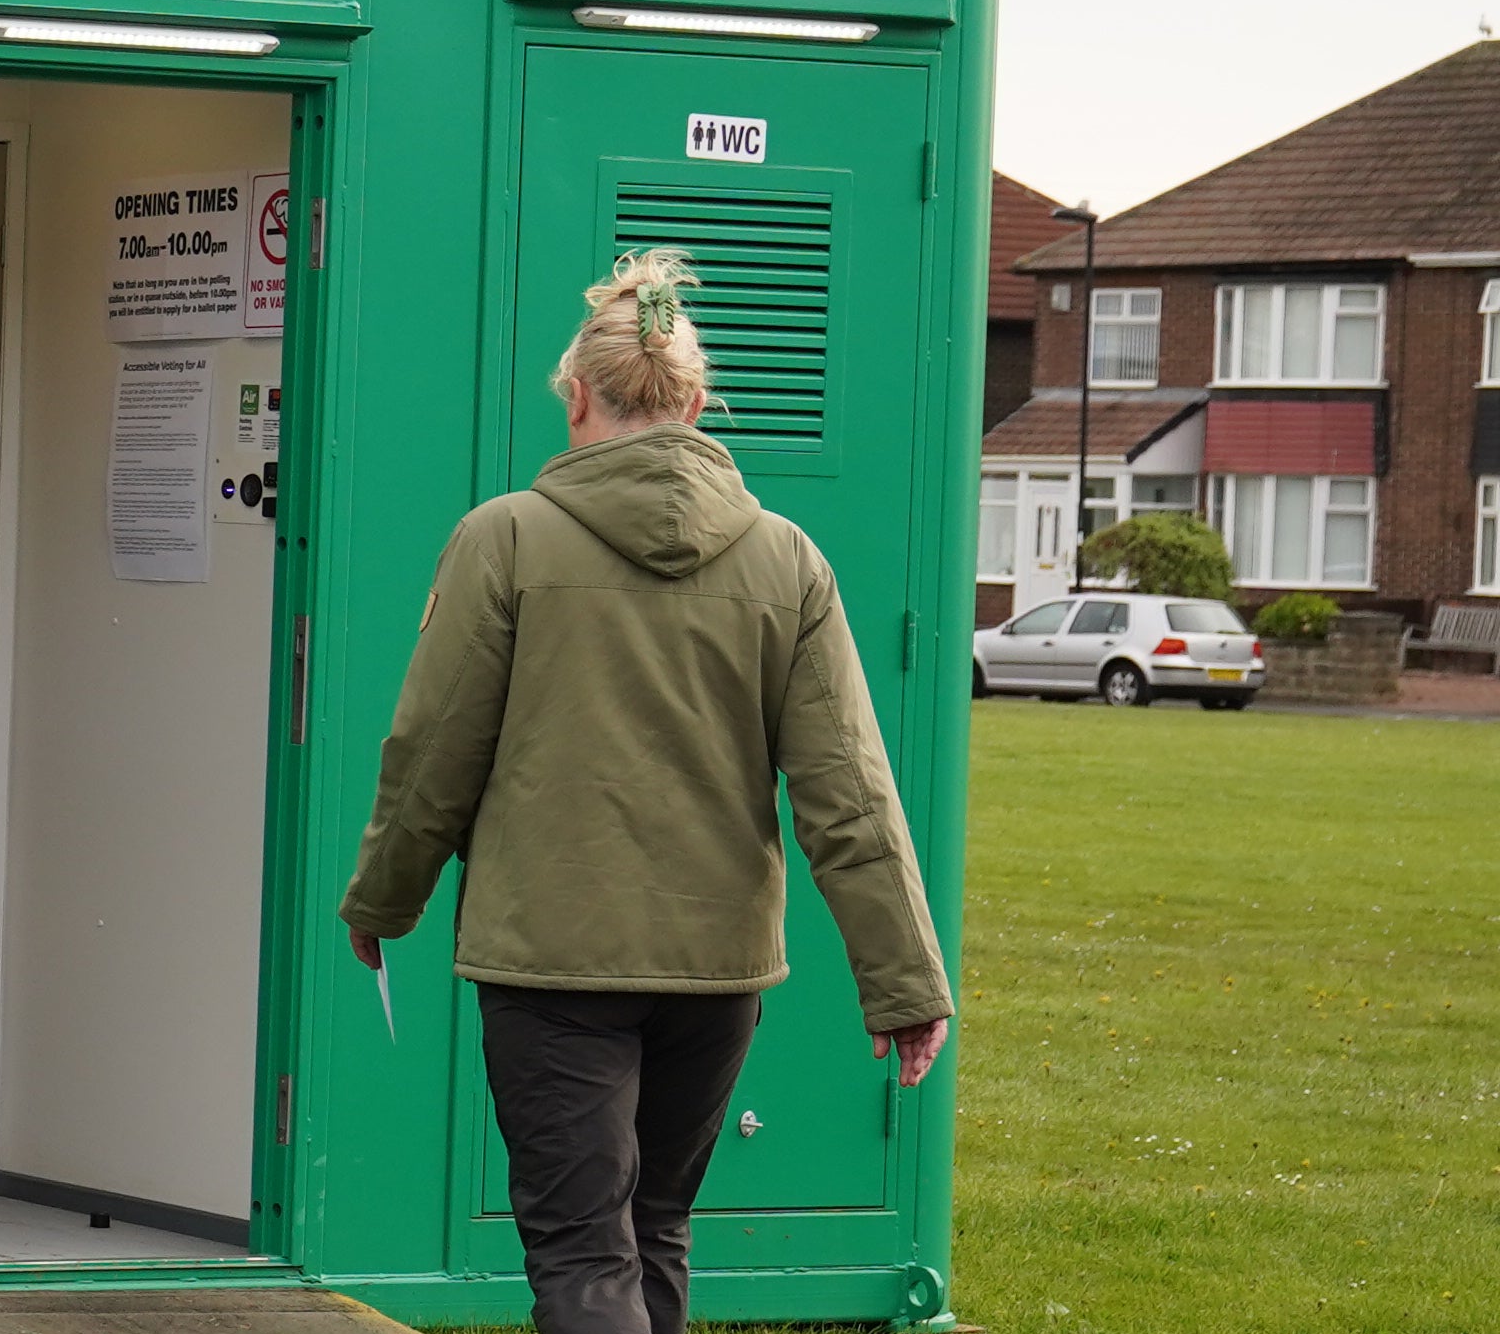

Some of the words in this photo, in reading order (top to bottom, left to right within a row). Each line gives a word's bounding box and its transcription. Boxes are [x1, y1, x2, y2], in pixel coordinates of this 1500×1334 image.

[721, 124, 761, 155] WC
[114, 189, 180, 221] OPENING
[185, 186, 239, 215] TIMES
[164, 279, 178, 289] you
[178, 277, 190, 287] are
[198, 275, 208, 285] the
[209, 274, 232, 286] polling
[250, 279, 264, 292] NO
[189, 289, 209, 300] before
[162, 304, 181, 316] apply
[182, 303, 192, 313] for
[197, 302, 216, 313] ballot
[216, 302, 238, 315] paper
[253, 297, 267, 309] OR
[161, 360, 185, 373] Voting
[185, 359, 196, 370] for
[197, 359, 206, 369] All
[242, 390, 257, 403] Air
